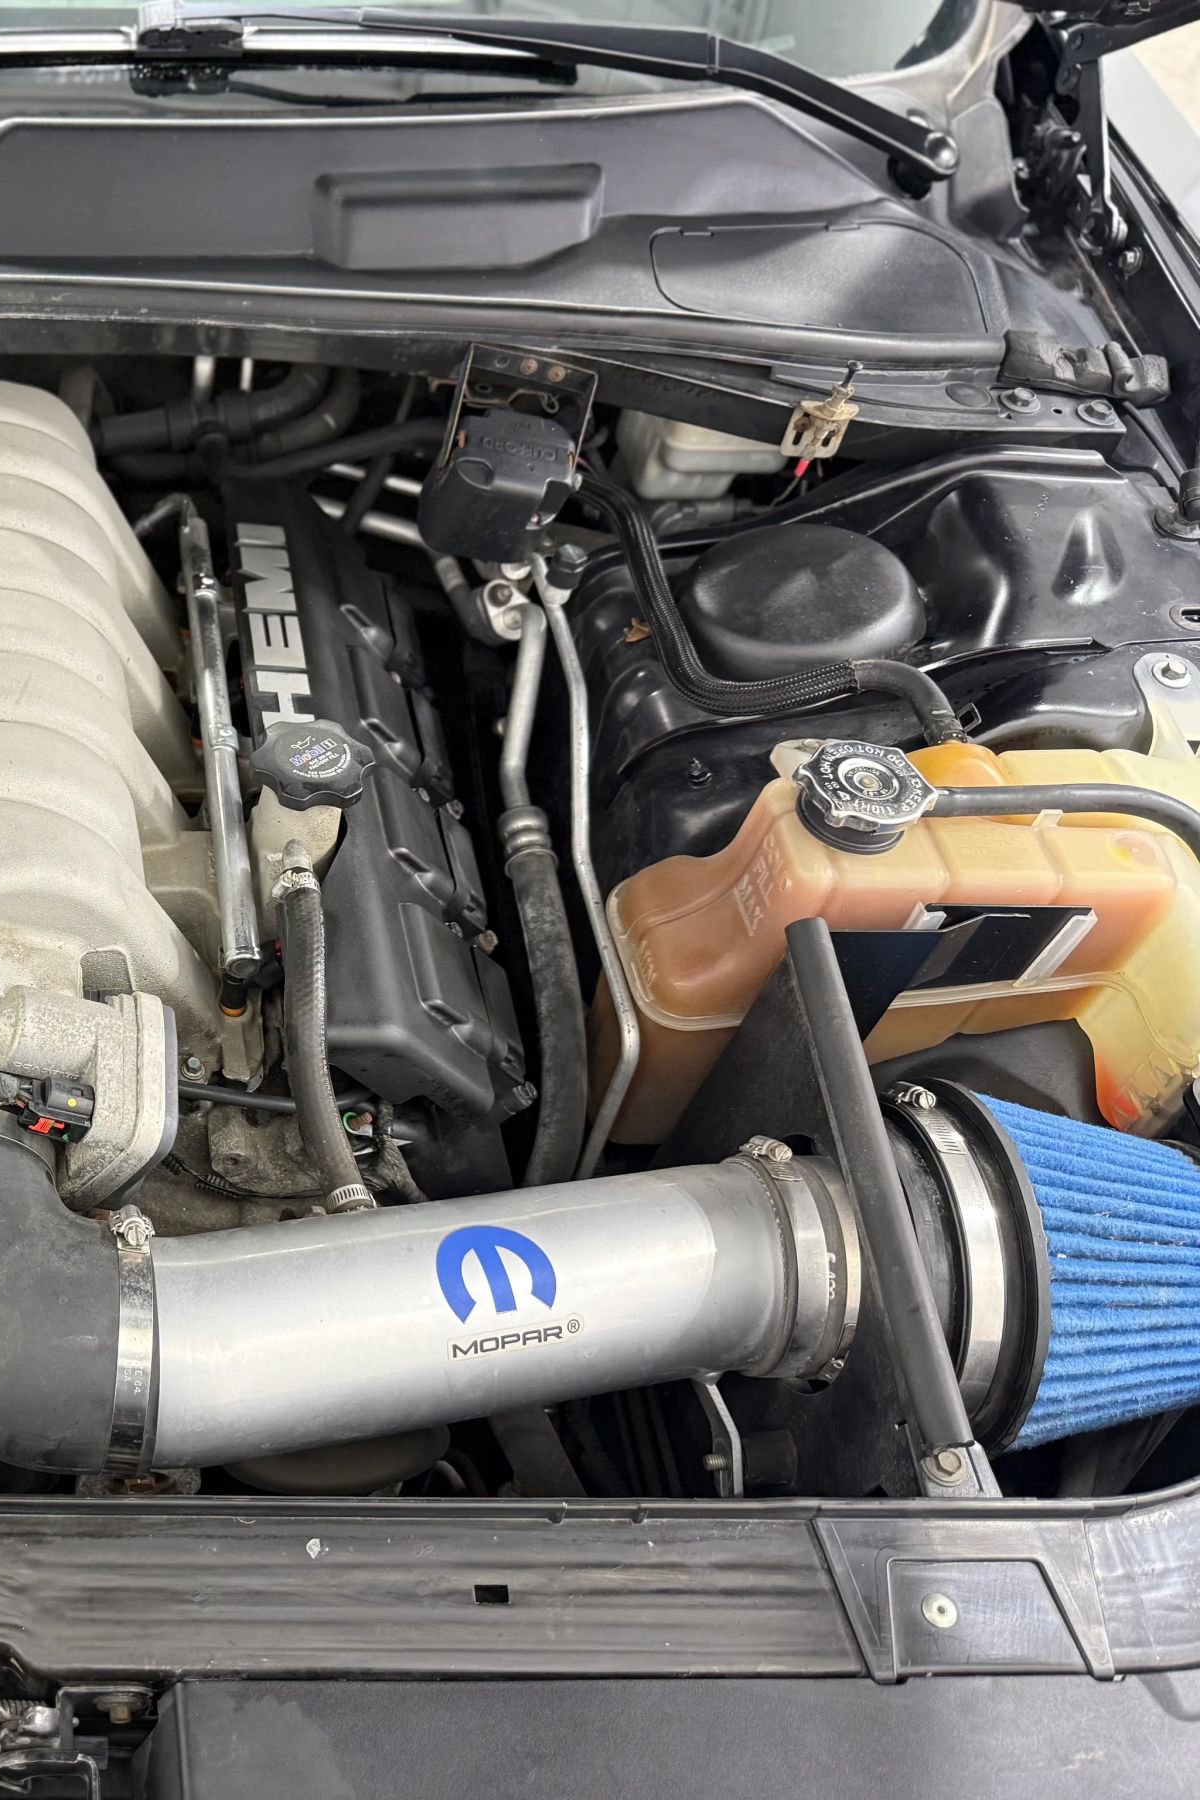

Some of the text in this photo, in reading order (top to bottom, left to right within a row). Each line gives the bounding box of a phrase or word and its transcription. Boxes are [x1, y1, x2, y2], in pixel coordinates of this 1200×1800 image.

[235, 522, 316, 728] HEMI
[289, 744, 326, 767] Mobil
[857, 744, 884, 758] NOT
[887, 753, 906, 768] DO
[819, 760, 833, 780] HOT
[901, 788, 924, 812] KEEP
